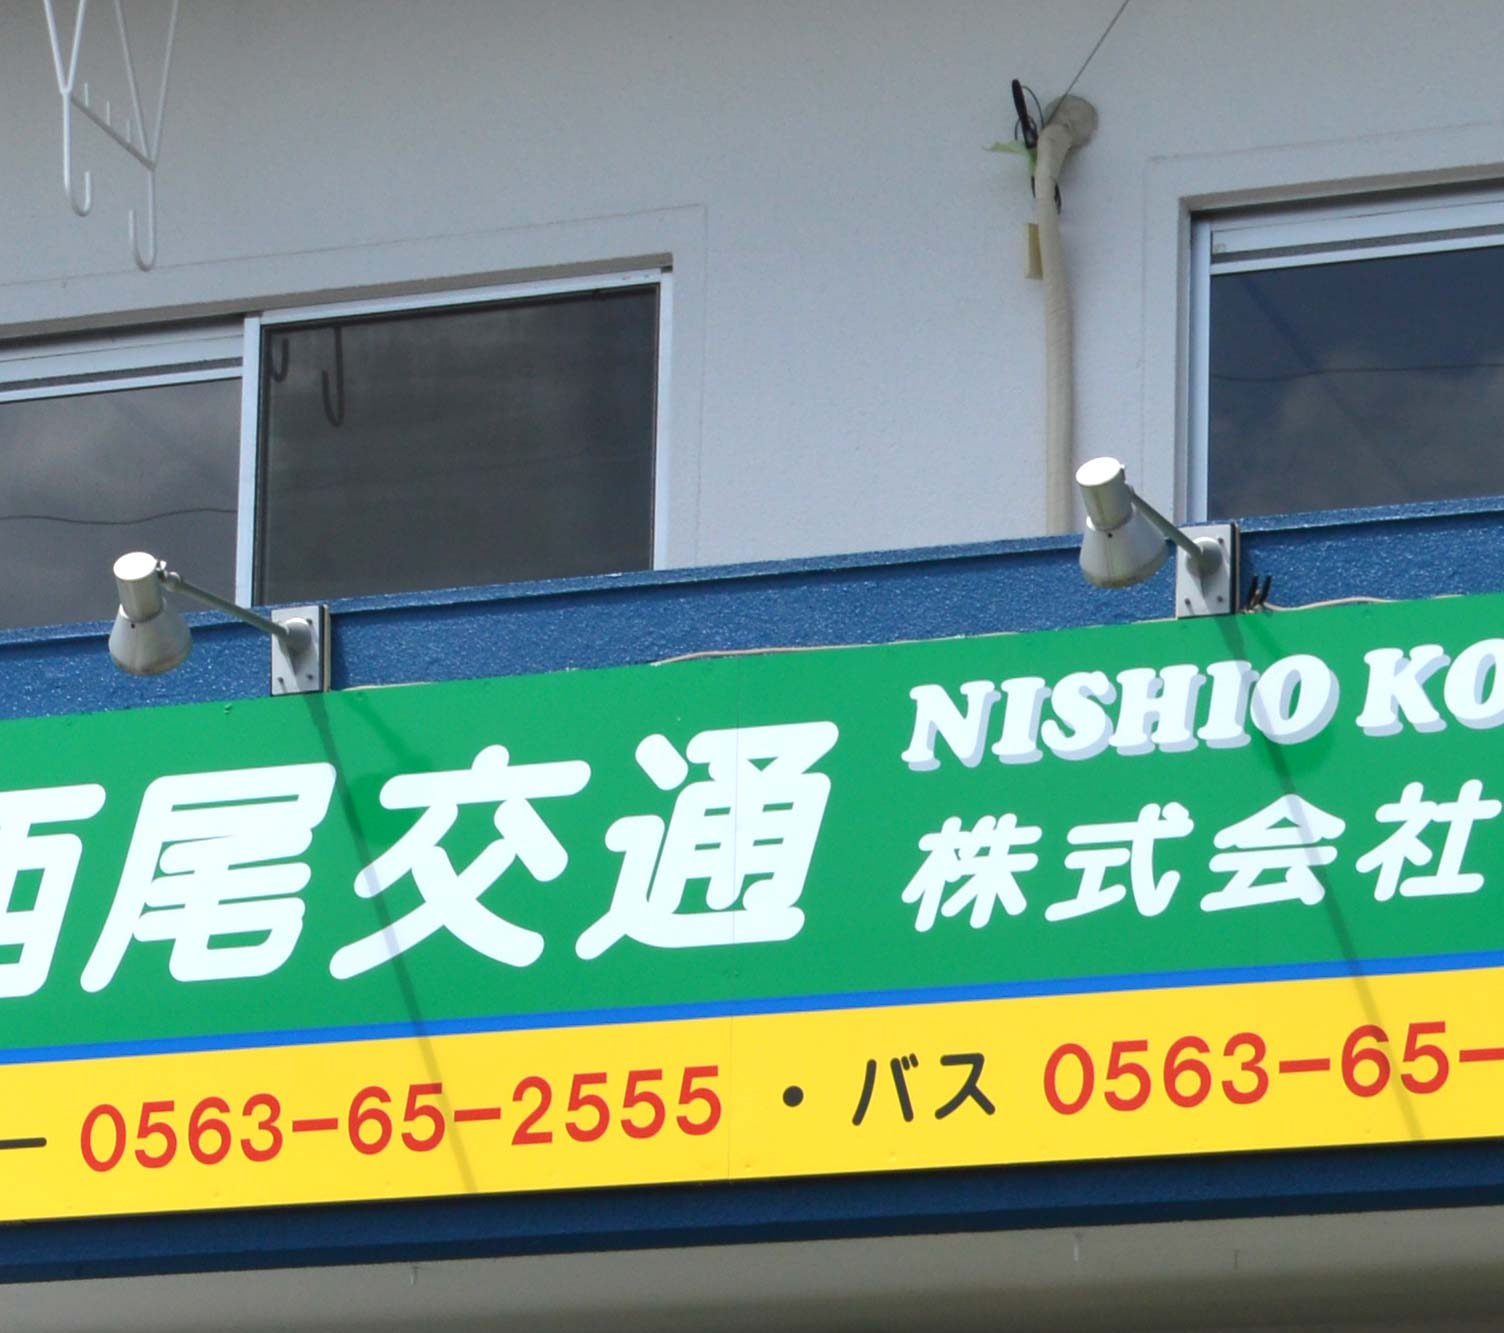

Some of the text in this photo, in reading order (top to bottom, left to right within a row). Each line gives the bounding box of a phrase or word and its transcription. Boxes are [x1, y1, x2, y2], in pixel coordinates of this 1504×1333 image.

[901, 649, 1342, 770] NISHIO
[903, 779, 1502, 934] 株式会社
[78, 1063, 724, 1176] 0563-65-2555
[850, 1050, 997, 1132] バス
